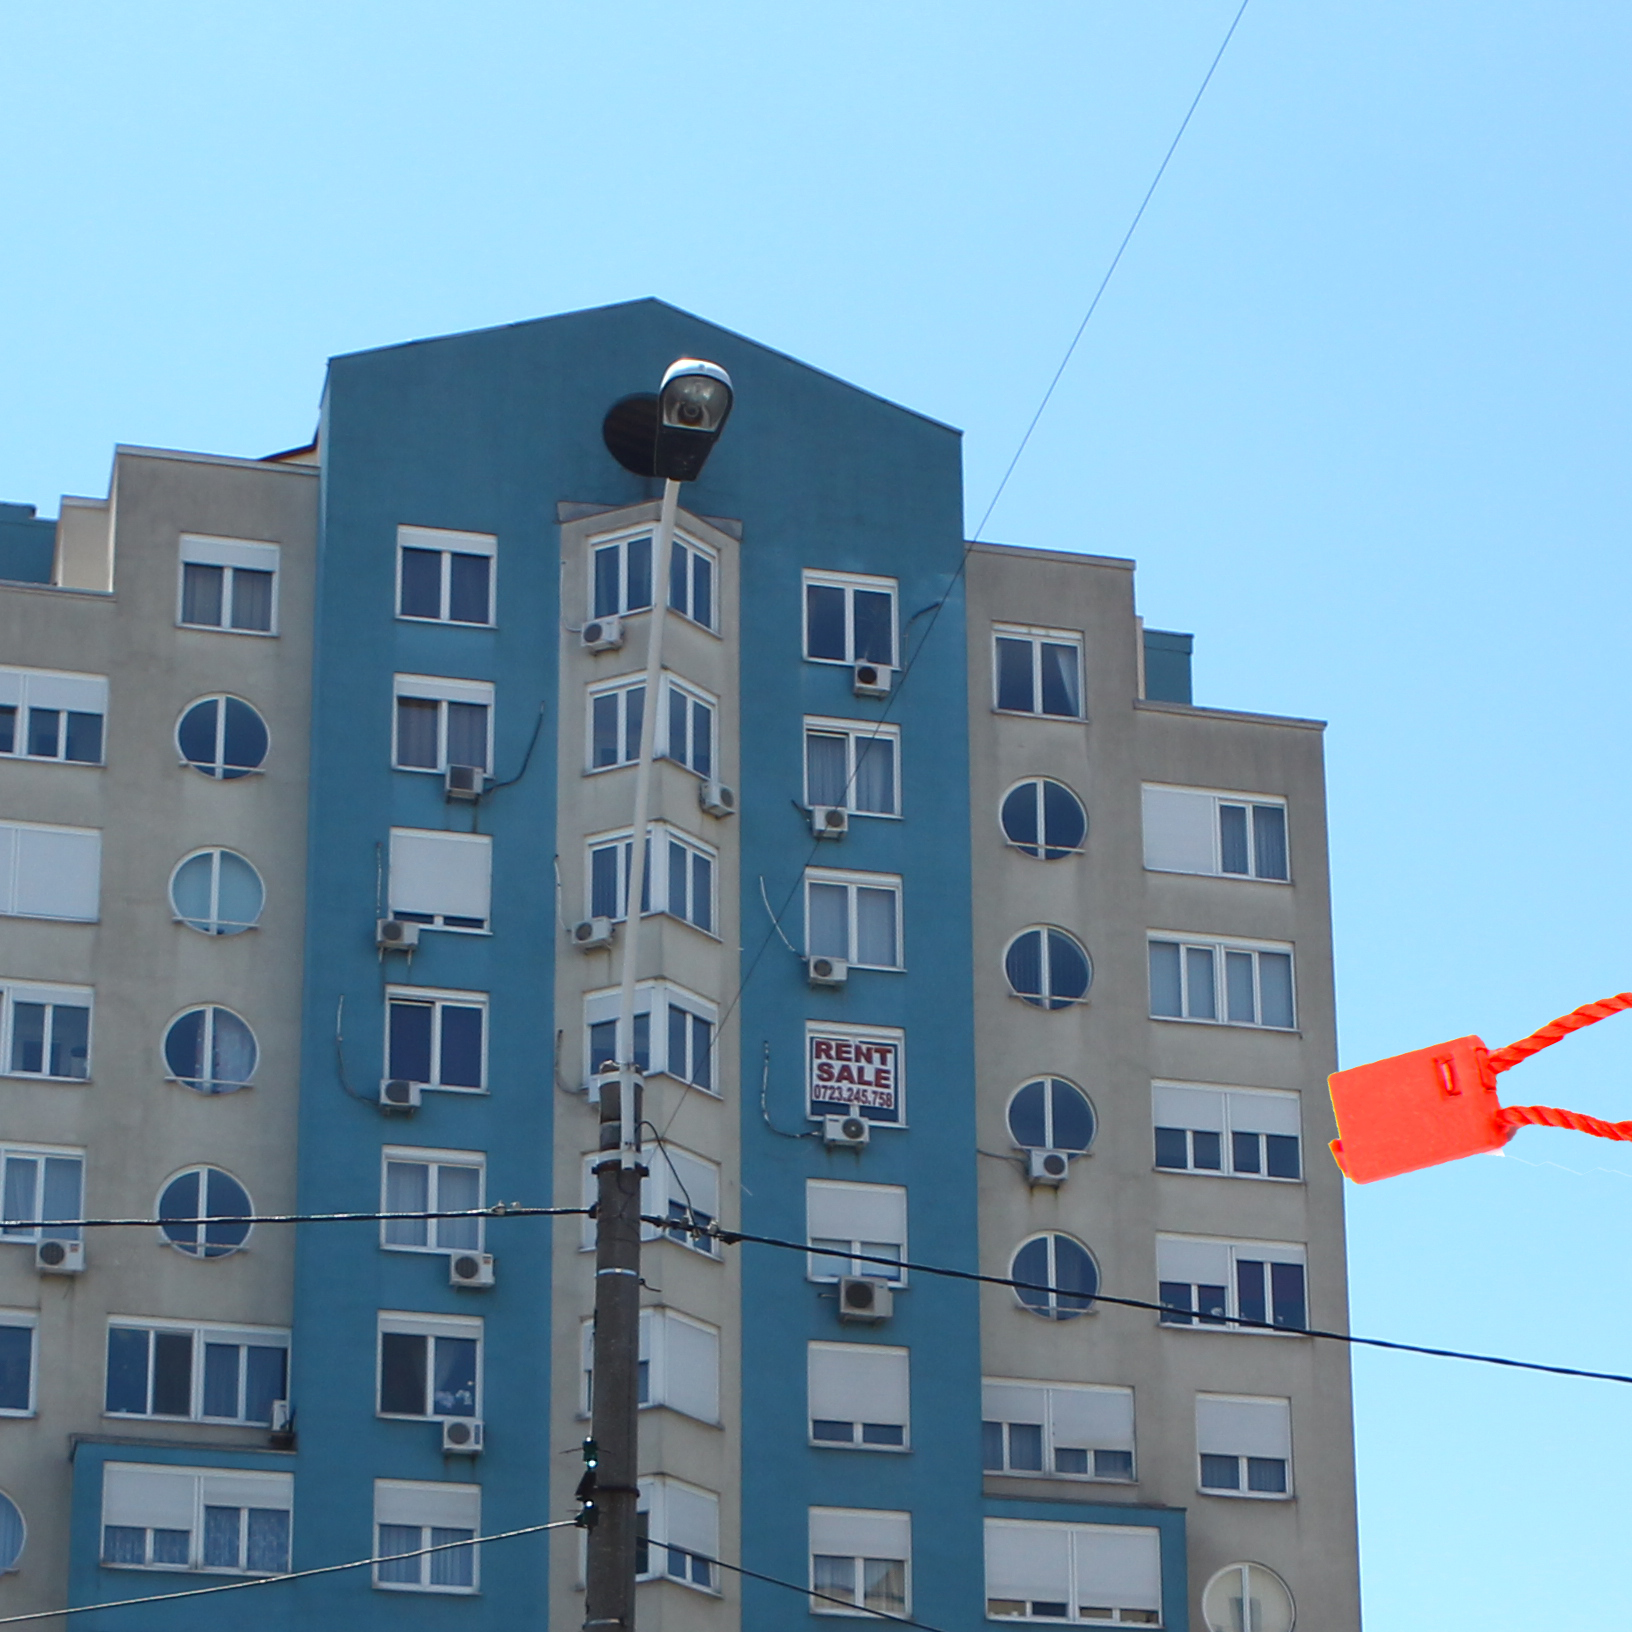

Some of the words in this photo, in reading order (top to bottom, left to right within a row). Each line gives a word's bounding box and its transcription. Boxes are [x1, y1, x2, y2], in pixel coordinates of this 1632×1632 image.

[814, 1040, 893, 1067] RENT
[816, 1062, 893, 1089] SALE
[813, 1085, 893, 1108] 0723.245.758
